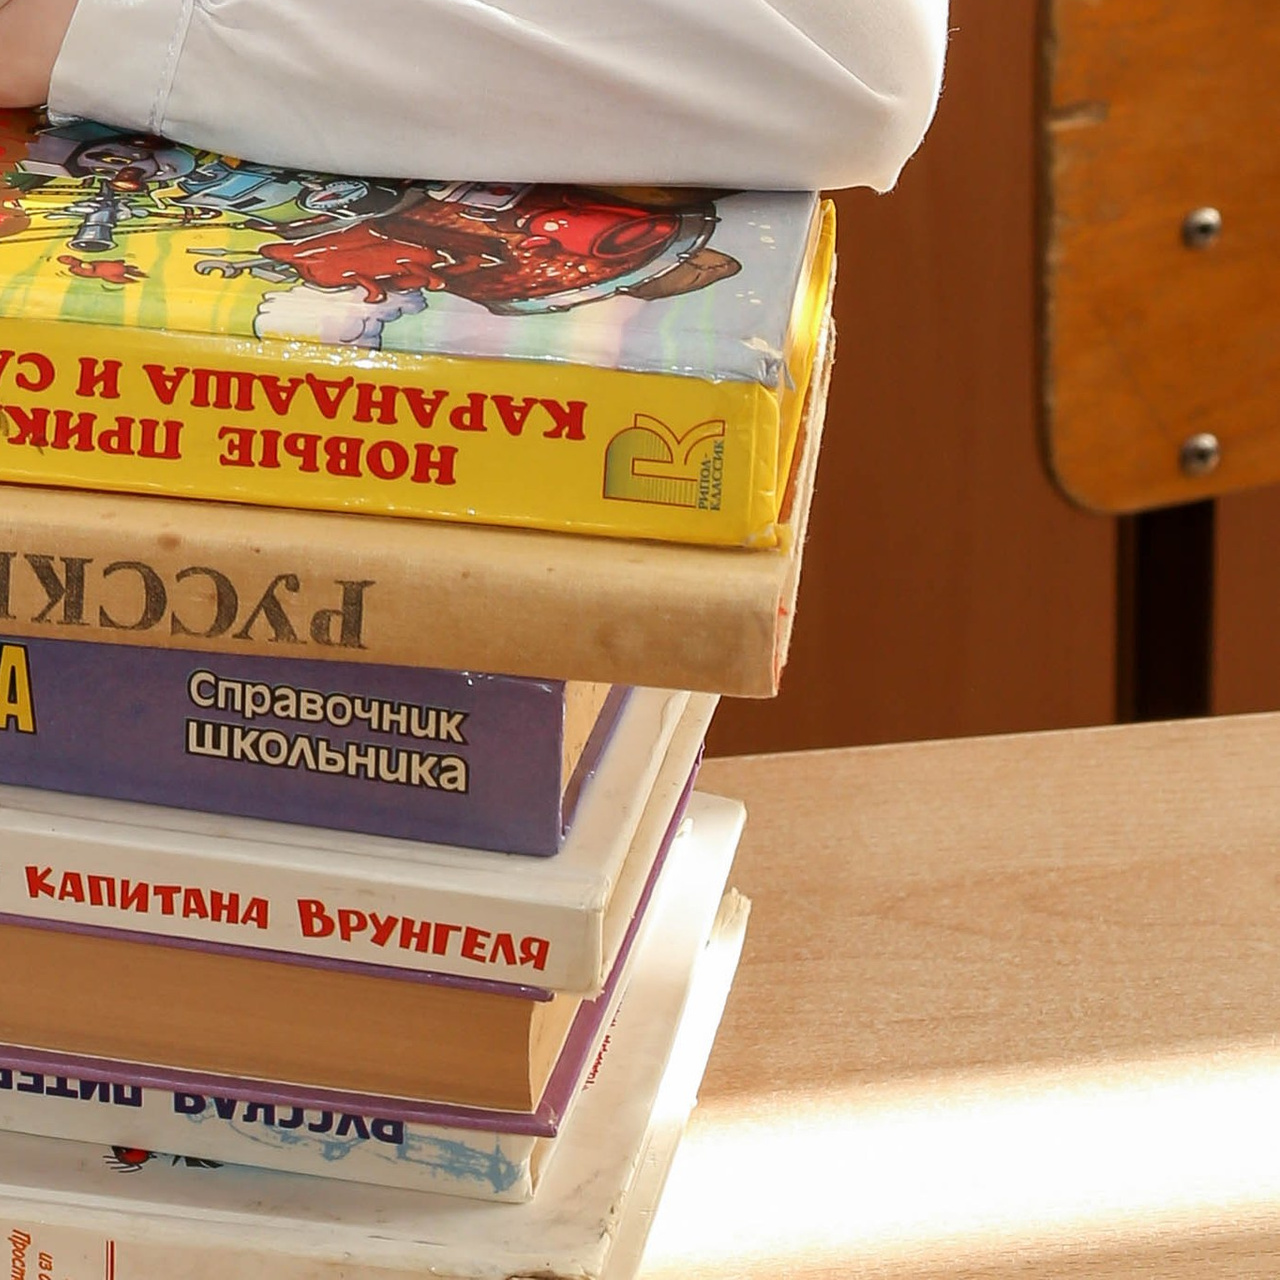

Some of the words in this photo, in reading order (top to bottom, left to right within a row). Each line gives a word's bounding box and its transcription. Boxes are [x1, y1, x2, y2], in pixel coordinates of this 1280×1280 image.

[75, 356, 122, 399] И
[143, 363, 587, 440] КАРАНДАША
[218, 426, 459, 485] НОВЫЕ
[186, 669, 470, 744] Справочник
[185, 718, 471, 795] школьника
